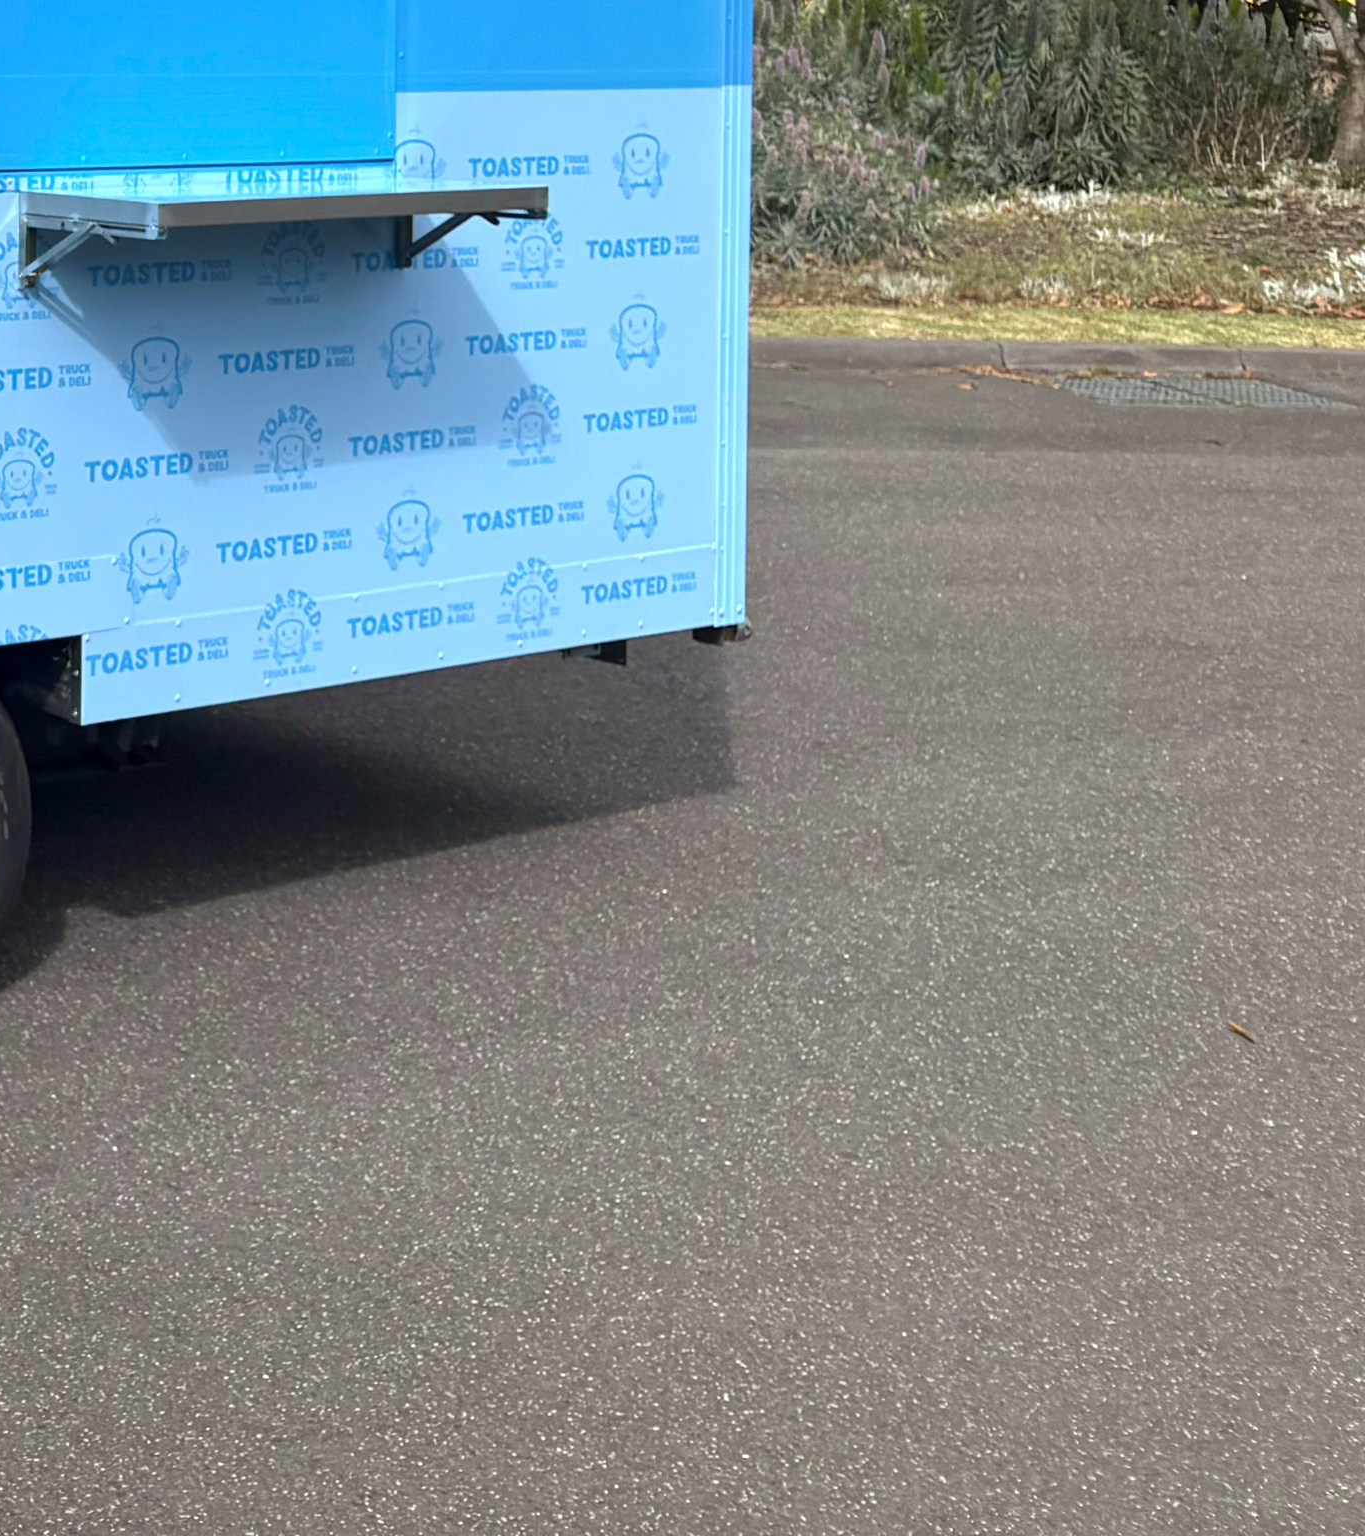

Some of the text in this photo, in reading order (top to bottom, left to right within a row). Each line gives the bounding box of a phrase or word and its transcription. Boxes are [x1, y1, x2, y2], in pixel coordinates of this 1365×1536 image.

[468, 156, 559, 178] TOASTED
[586, 236, 671, 259] TOASTED
[86, 261, 195, 287] TOASTED
[465, 330, 556, 355] TOASTED
[218, 348, 321, 374] TOASTED
[583, 407, 669, 433] TOASTED
[348, 429, 444, 457] TOASTED
[84, 453, 193, 483] TOASTED
[462, 505, 553, 533] TOASTED
[216, 533, 318, 564] TOASTED
[581, 575, 667, 604] TOASTED
[347, 607, 443, 638] TOASTED
[86, 639, 192, 676] TOASTED
